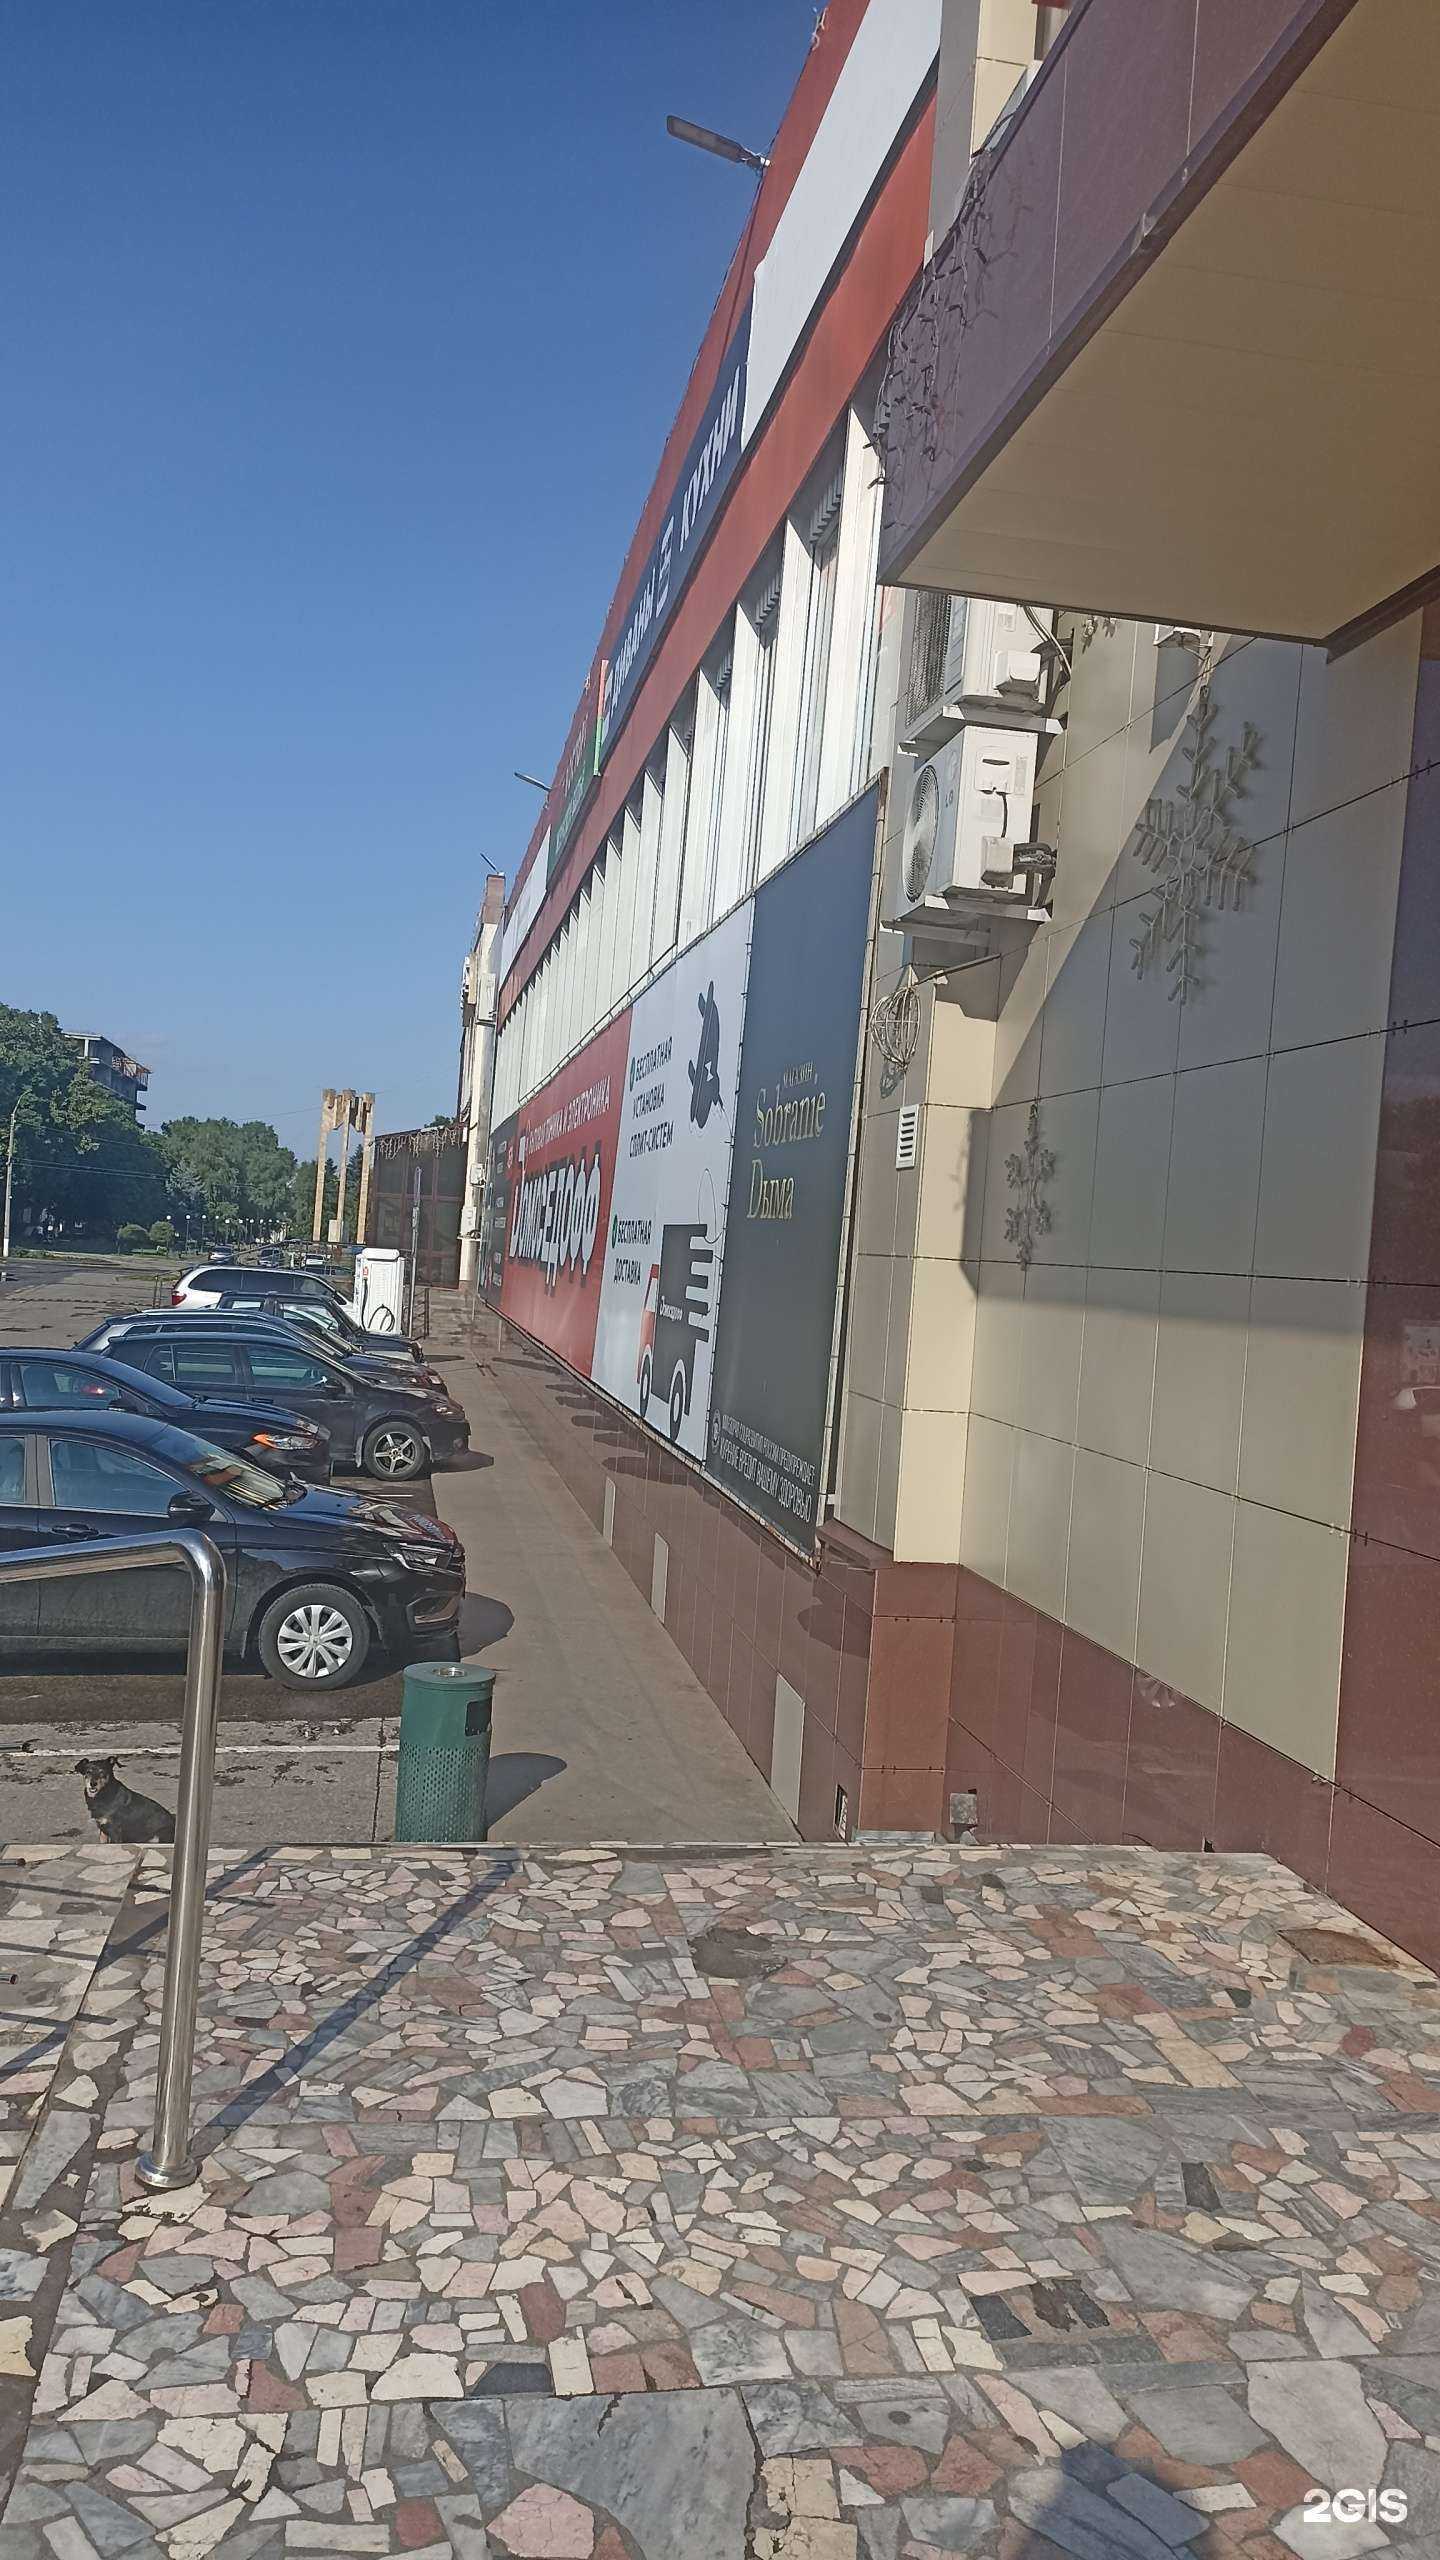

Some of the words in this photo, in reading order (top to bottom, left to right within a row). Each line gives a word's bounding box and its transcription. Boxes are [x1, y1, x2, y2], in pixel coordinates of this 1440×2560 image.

[611, 567, 656, 719] ДИВАНЫ
[680, 365, 740, 552] КУХНИ
[636, 1036, 673, 1082] БЕСПЛАТНАЯ
[632, 1082, 665, 1120] УСТАНОВКА
[753, 1072, 826, 1149] Sobranie
[630, 1120, 674, 1158] СПЛИТ-СИСТЕМ
[618, 1220, 652, 1245] БЕСПЛАТНАЯ
[614, 1258, 641, 1285] ДОСТАВКА
[779, 1476, 812, 1523] ЗДОРОВЬЮ
